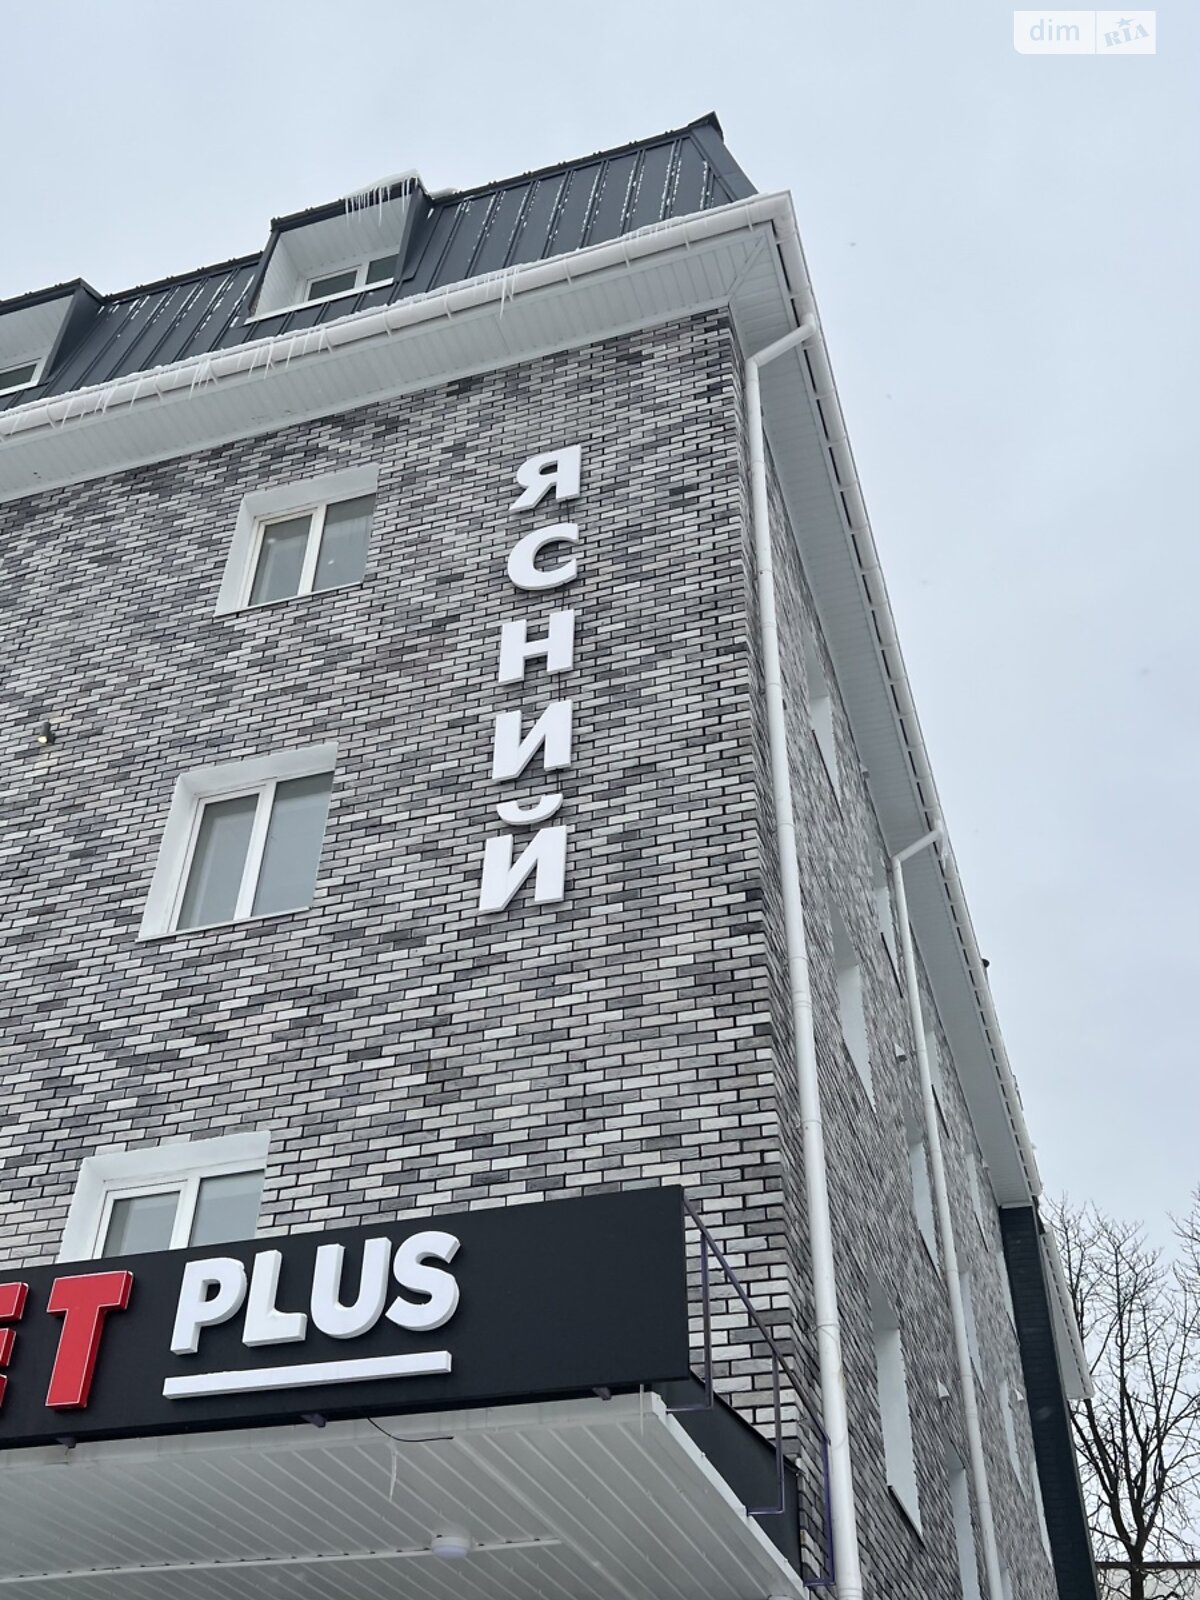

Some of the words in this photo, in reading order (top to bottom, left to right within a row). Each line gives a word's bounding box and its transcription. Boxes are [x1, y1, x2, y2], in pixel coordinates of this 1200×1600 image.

[479, 444, 582, 914] ЯСНИЙ
[0, 1270, 134, 1412] T
[169, 1230, 461, 1356] PLUS
